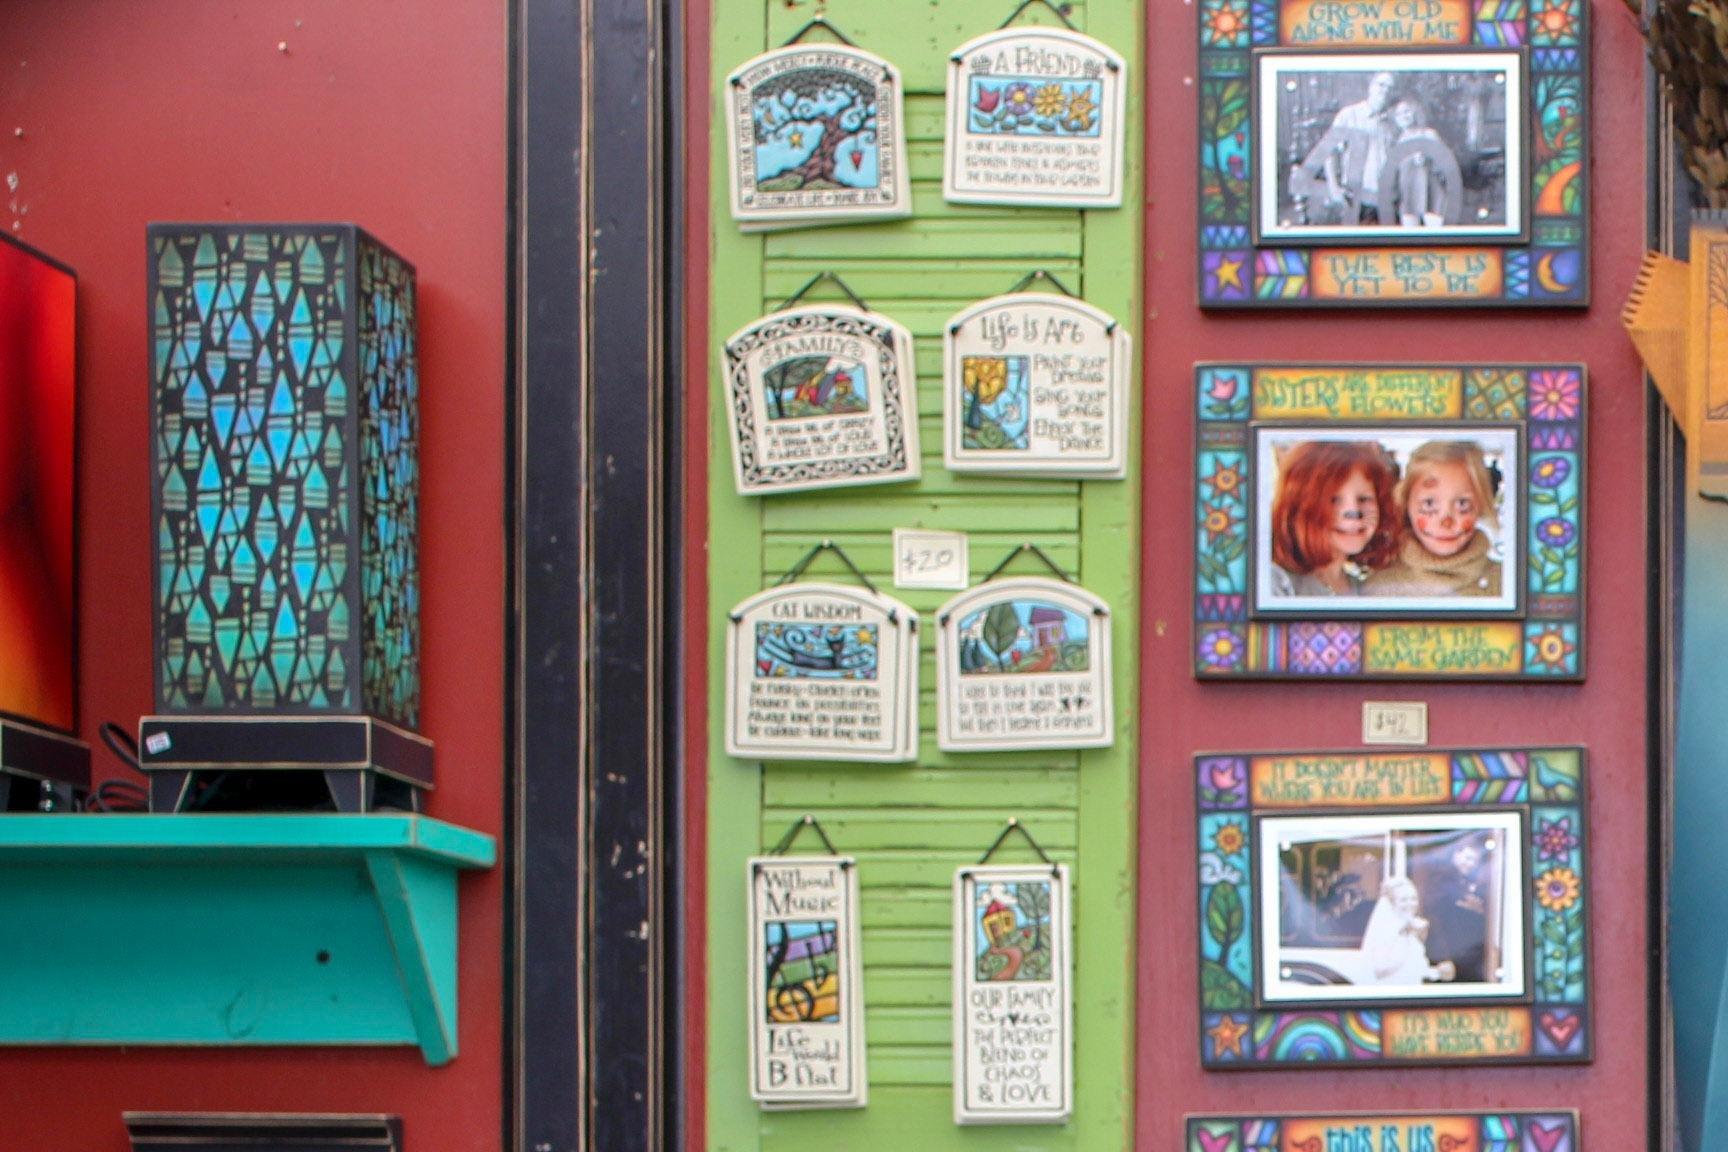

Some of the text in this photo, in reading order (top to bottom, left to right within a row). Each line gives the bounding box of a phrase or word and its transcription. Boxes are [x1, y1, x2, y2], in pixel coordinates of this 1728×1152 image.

[1309, 0, 1441, 20] GROW OLD
[1292, 23, 1458, 42] ALONG WITH ME
[993, 50, 1009, 72] A
[1327, 254, 1486, 276] THE BEST IS
[1334, 274, 1478, 295] YET TO BE
[1023, 314, 1039, 340] is
[1259, 374, 1341, 417] SISTERS
[903, 548, 953, 571] $20
[773, 602, 861, 618] CAT WISDOM
[767, 893, 836, 916] Music
[973, 986, 1054, 1008] OUR FAMILY
[986, 1064, 1041, 1081] CHAOS
[1001, 1082, 1051, 1101] LOVE
